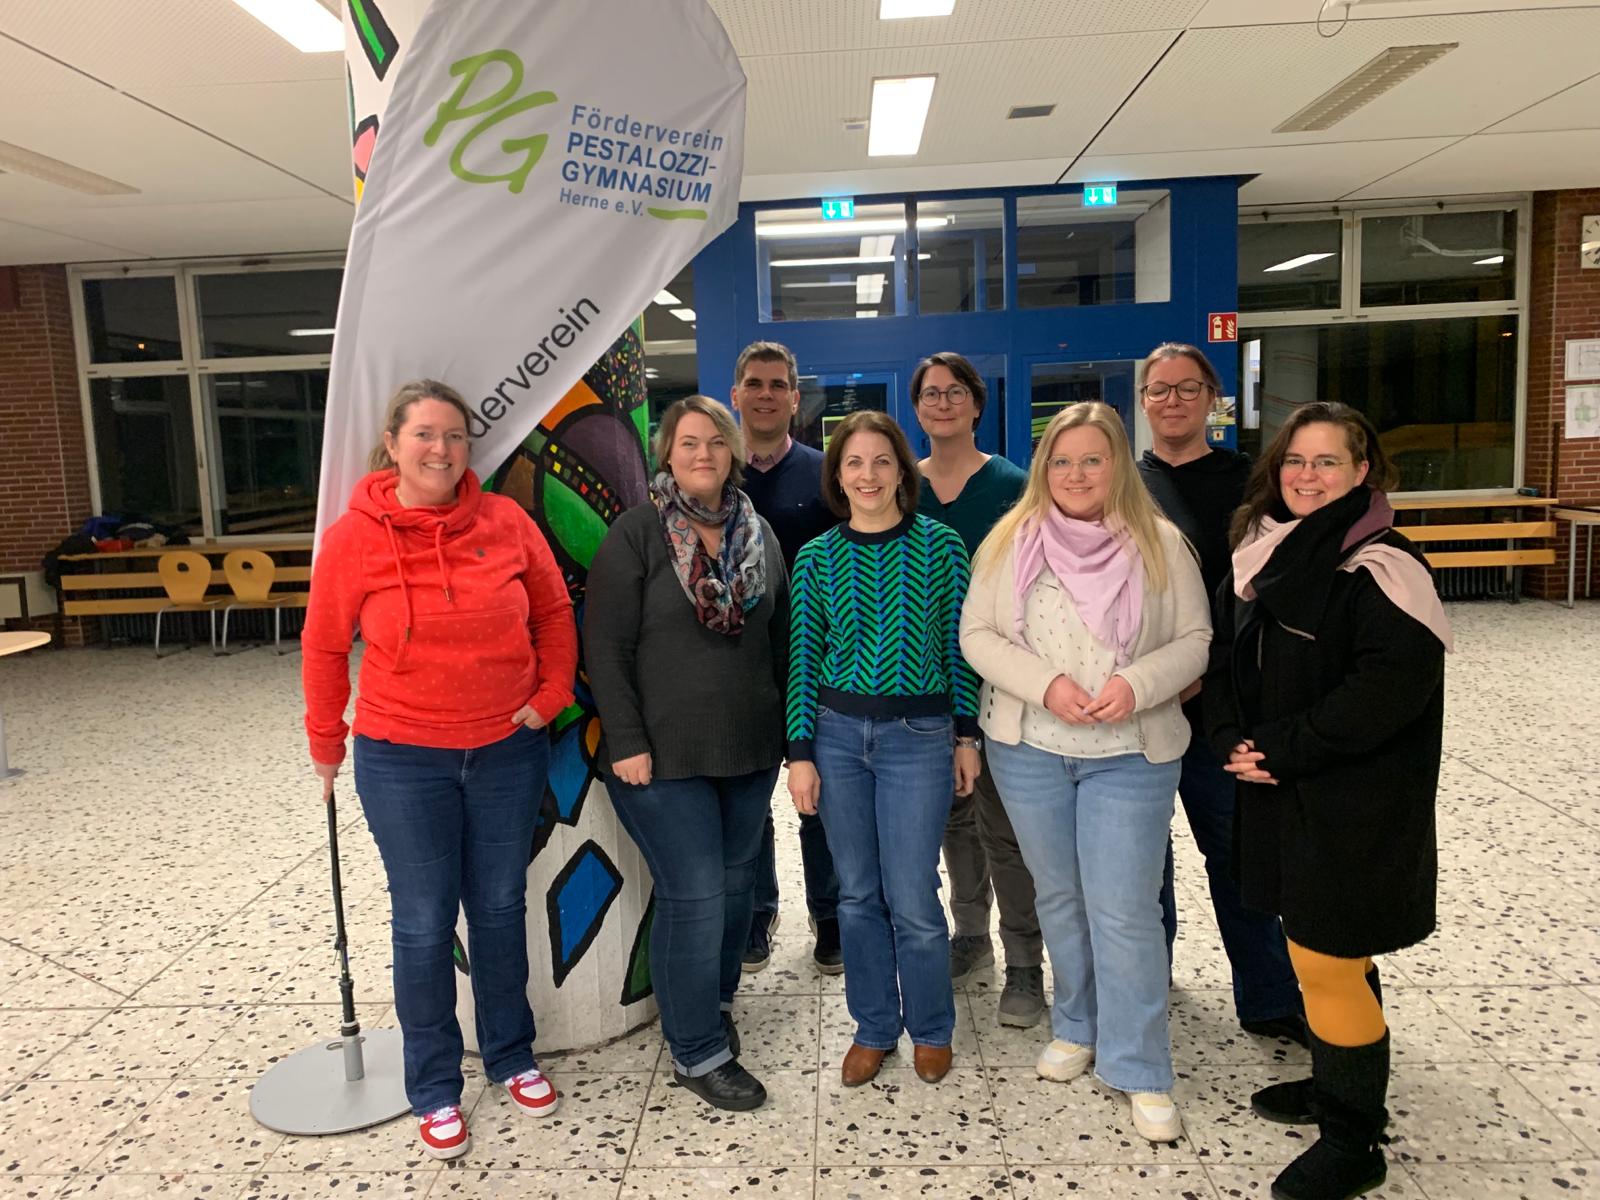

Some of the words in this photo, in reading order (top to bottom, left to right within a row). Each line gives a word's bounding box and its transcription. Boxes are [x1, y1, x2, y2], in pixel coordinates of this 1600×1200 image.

[571, 104, 723, 151] Förderverein
[567, 131, 717, 176] PESTALOZZI-
[559, 187, 609, 210] Herne
[615, 199, 644, 217] e.V.
[561, 160, 712, 203] GYMNASIUM
